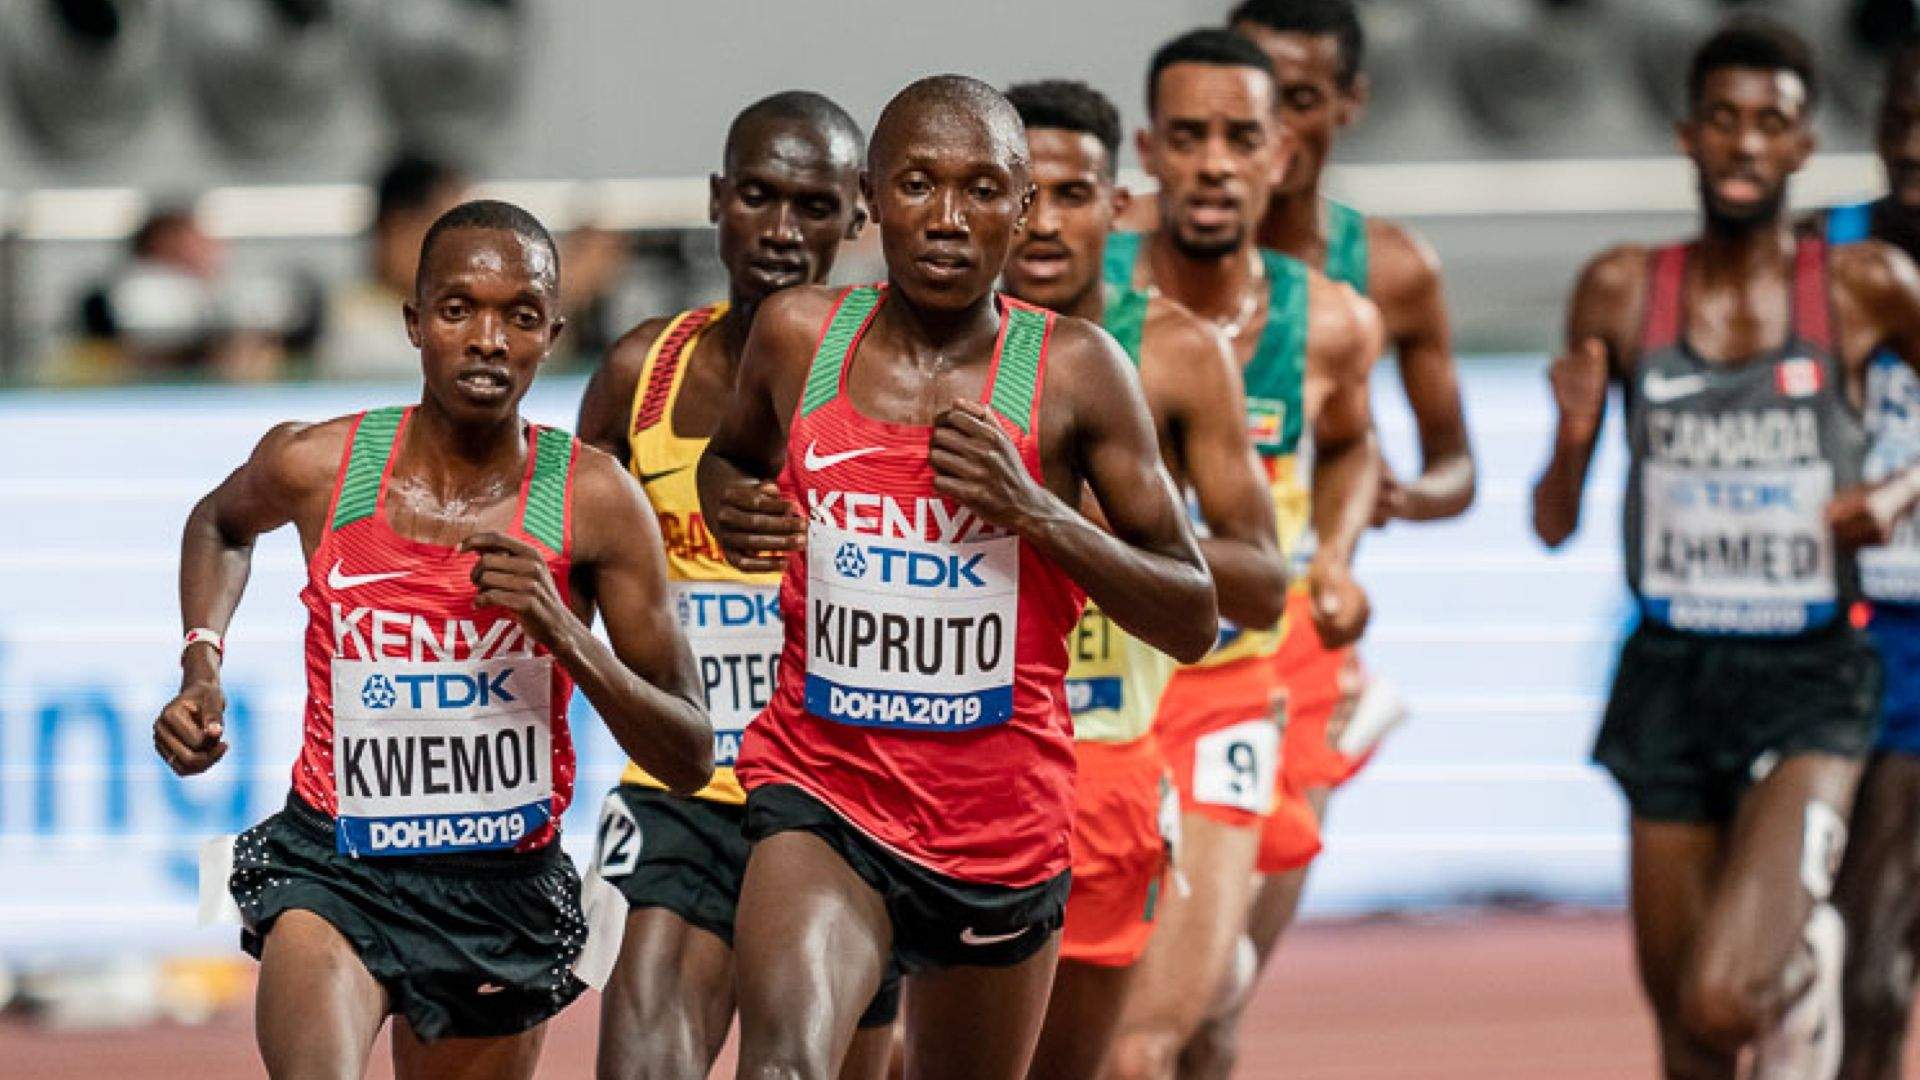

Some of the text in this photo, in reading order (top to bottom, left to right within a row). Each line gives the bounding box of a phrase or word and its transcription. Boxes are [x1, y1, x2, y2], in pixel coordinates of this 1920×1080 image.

[867, 545, 987, 588] TDK
[690, 592, 781, 628] TDK
[815, 600, 1003, 677] KIPRUTO
[395, 668, 516, 709] TDK
[830, 686, 982, 725] DOHA2019
[343, 726, 538, 797] KWEMOI
[1227, 741, 1259, 793] 9
[369, 812, 525, 850] DOHA2019
[598, 811, 636, 866] 12
